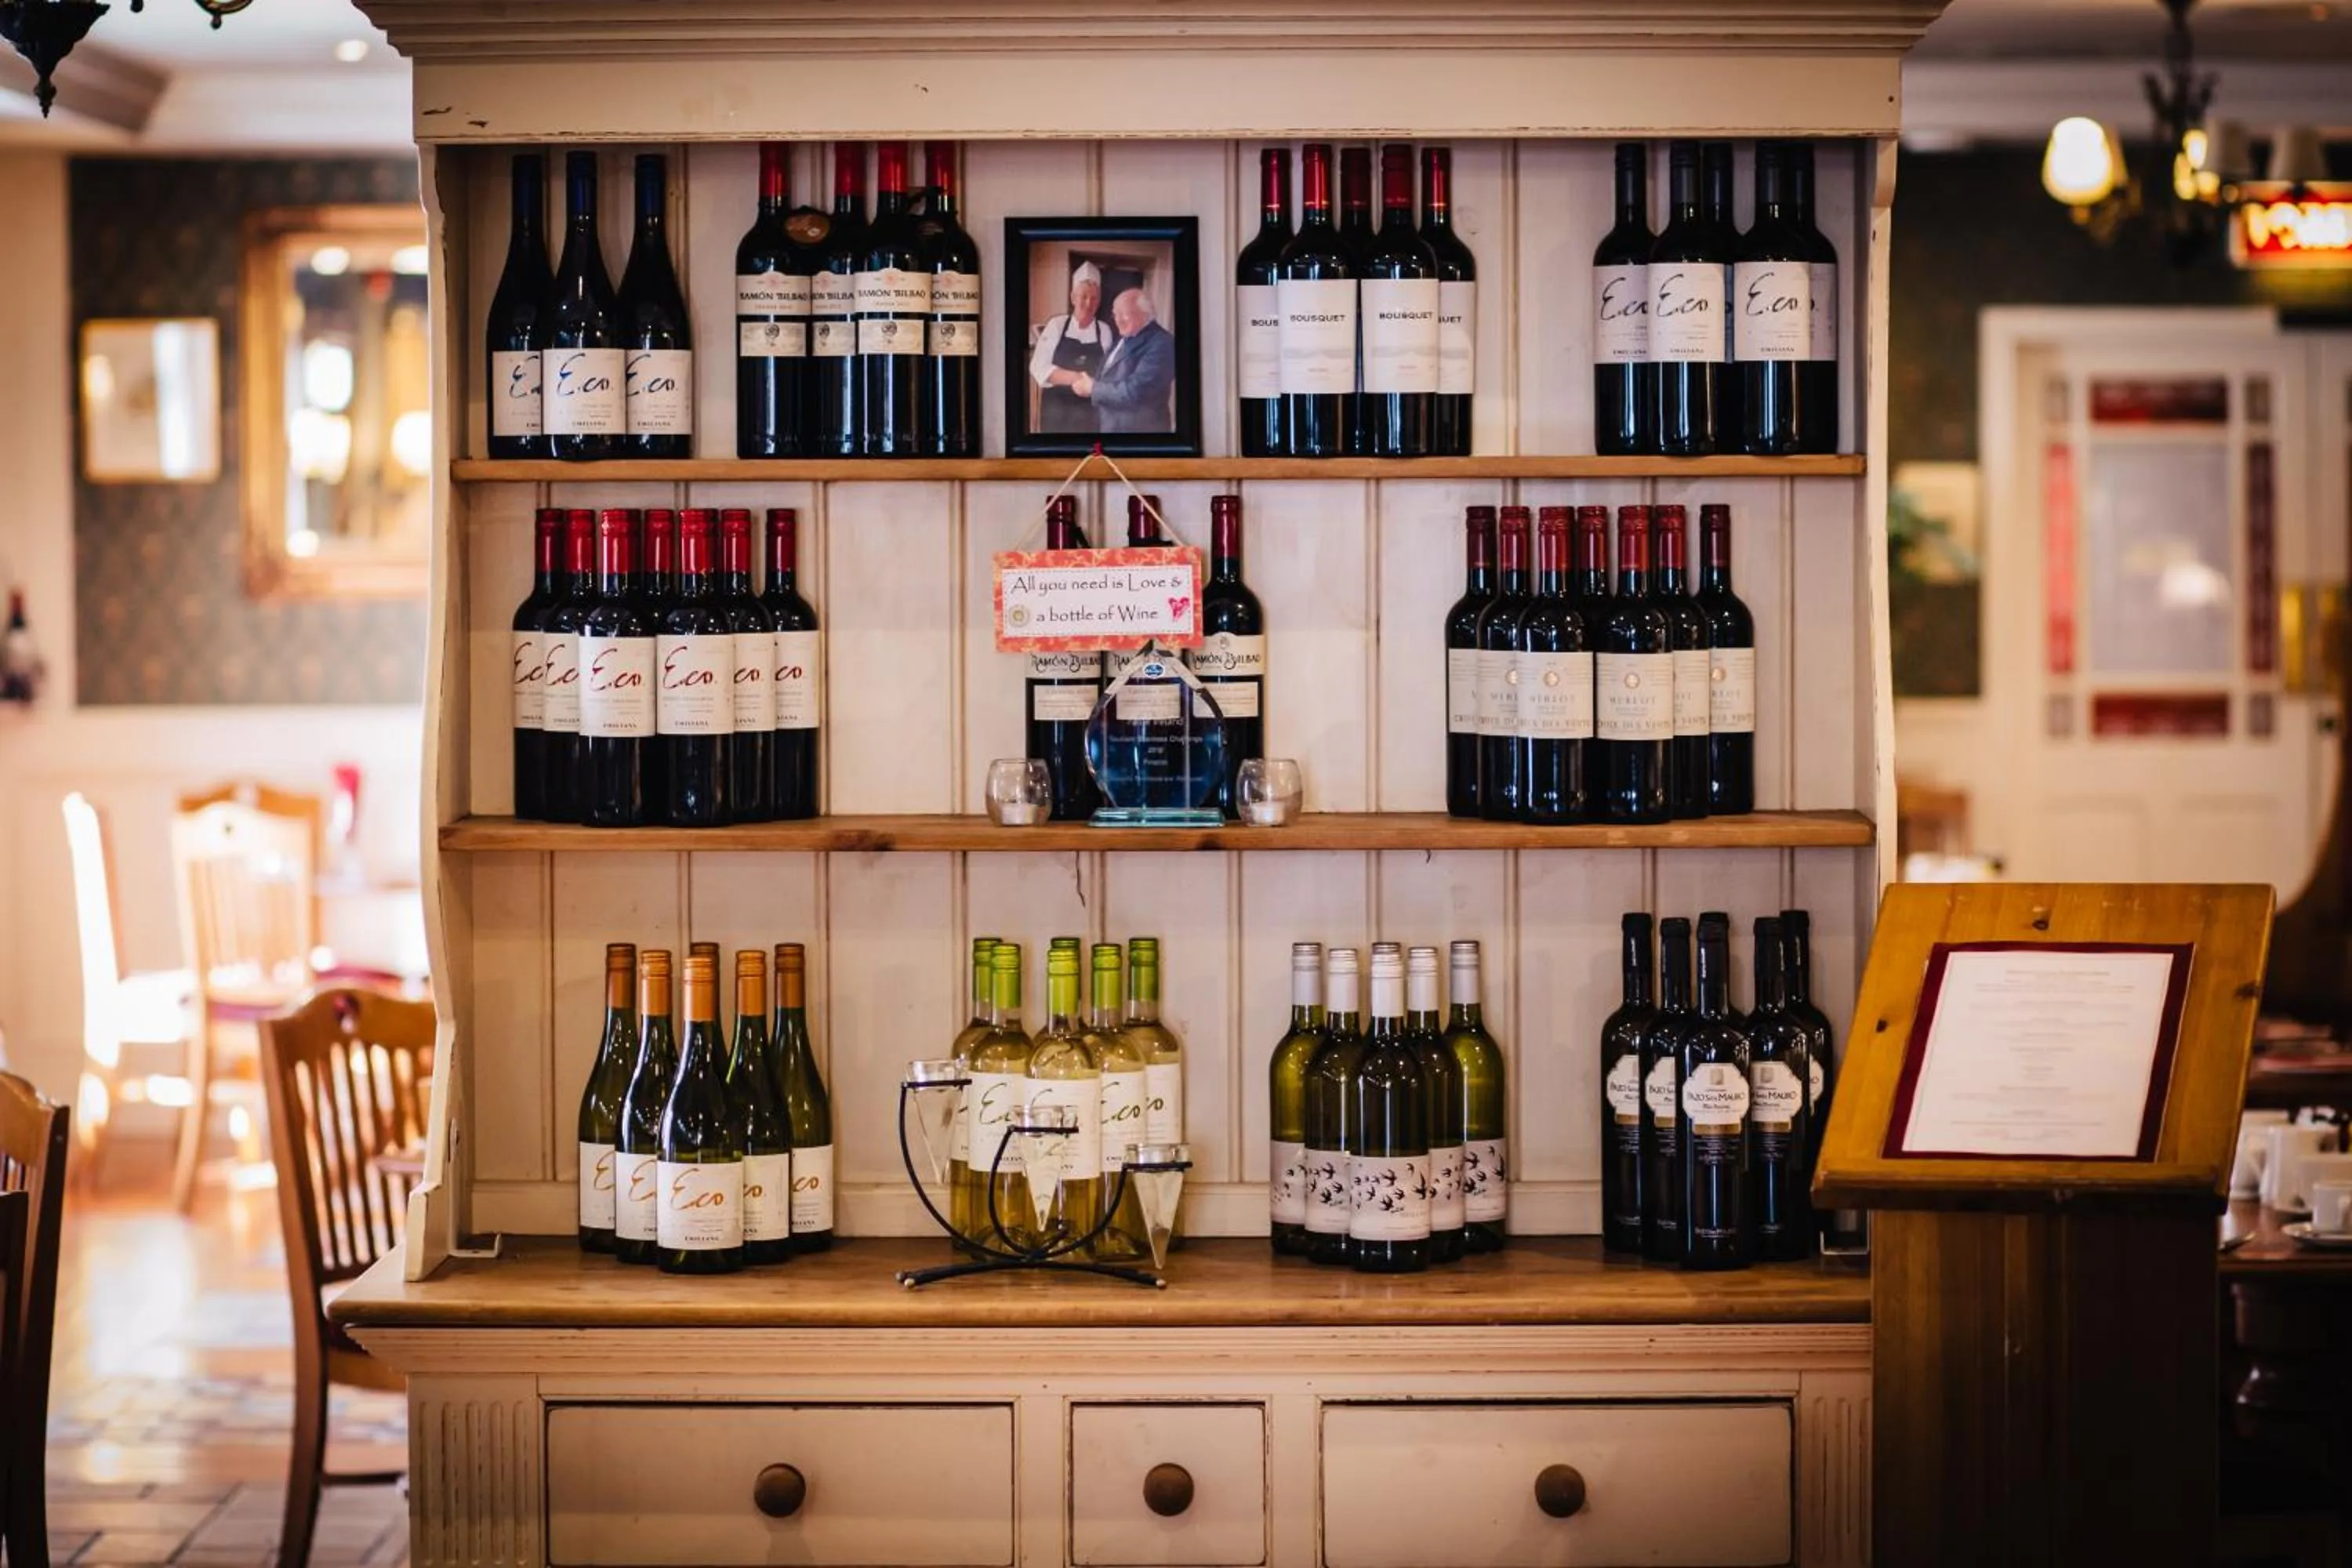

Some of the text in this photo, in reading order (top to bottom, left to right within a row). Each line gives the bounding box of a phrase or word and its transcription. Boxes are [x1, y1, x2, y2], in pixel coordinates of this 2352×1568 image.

[1657, 274, 1709, 317] Eco
[1746, 272, 1798, 316] Eco
[557, 353, 609, 396] Eco
[1011, 573, 1181, 597] All you need is Love &
[1036, 605, 1159, 622] a bottle of Wine
[546, 644, 579, 686] Ec
[590, 648, 641, 692] Eco
[662, 645, 713, 689] Eco
[734, 667, 760, 683] co
[775, 665, 802, 681] co
[671, 1167, 724, 1210] Eco
[792, 1176, 819, 1192] co
